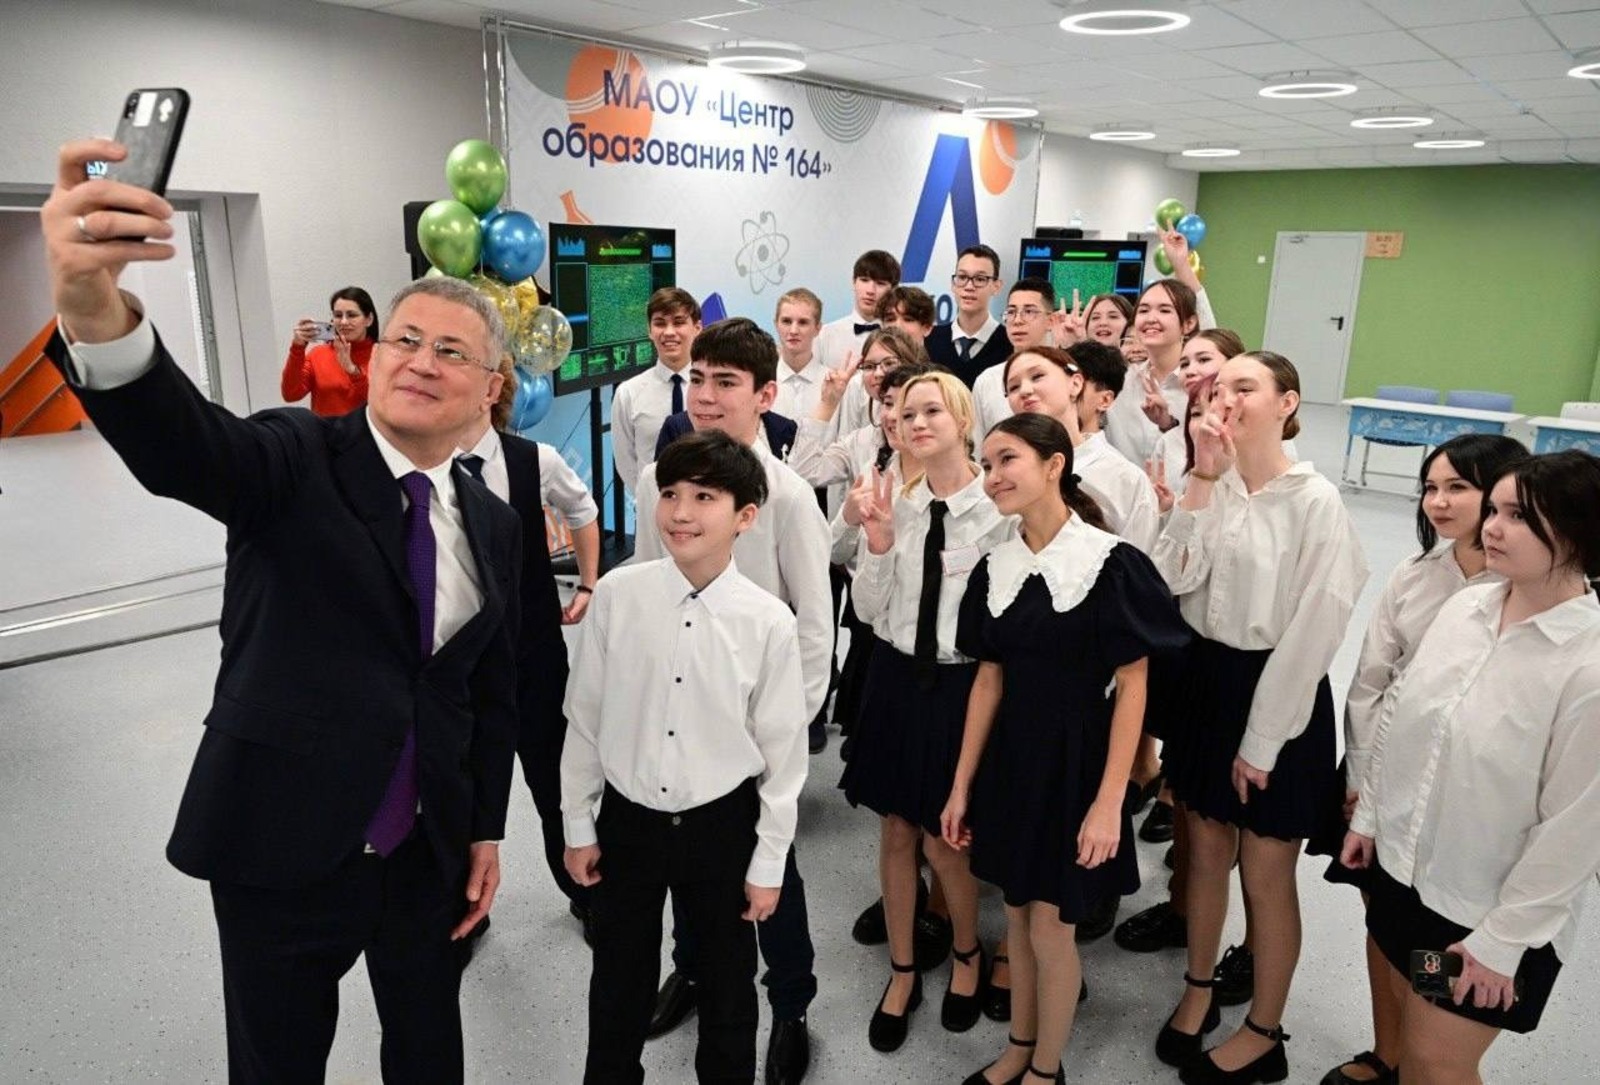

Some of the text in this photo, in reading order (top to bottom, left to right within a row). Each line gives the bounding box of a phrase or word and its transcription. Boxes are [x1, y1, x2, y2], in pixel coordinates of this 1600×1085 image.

[603, 69, 794, 136] МАОУ «Центр
[542, 122, 832, 179] образования № 164»
